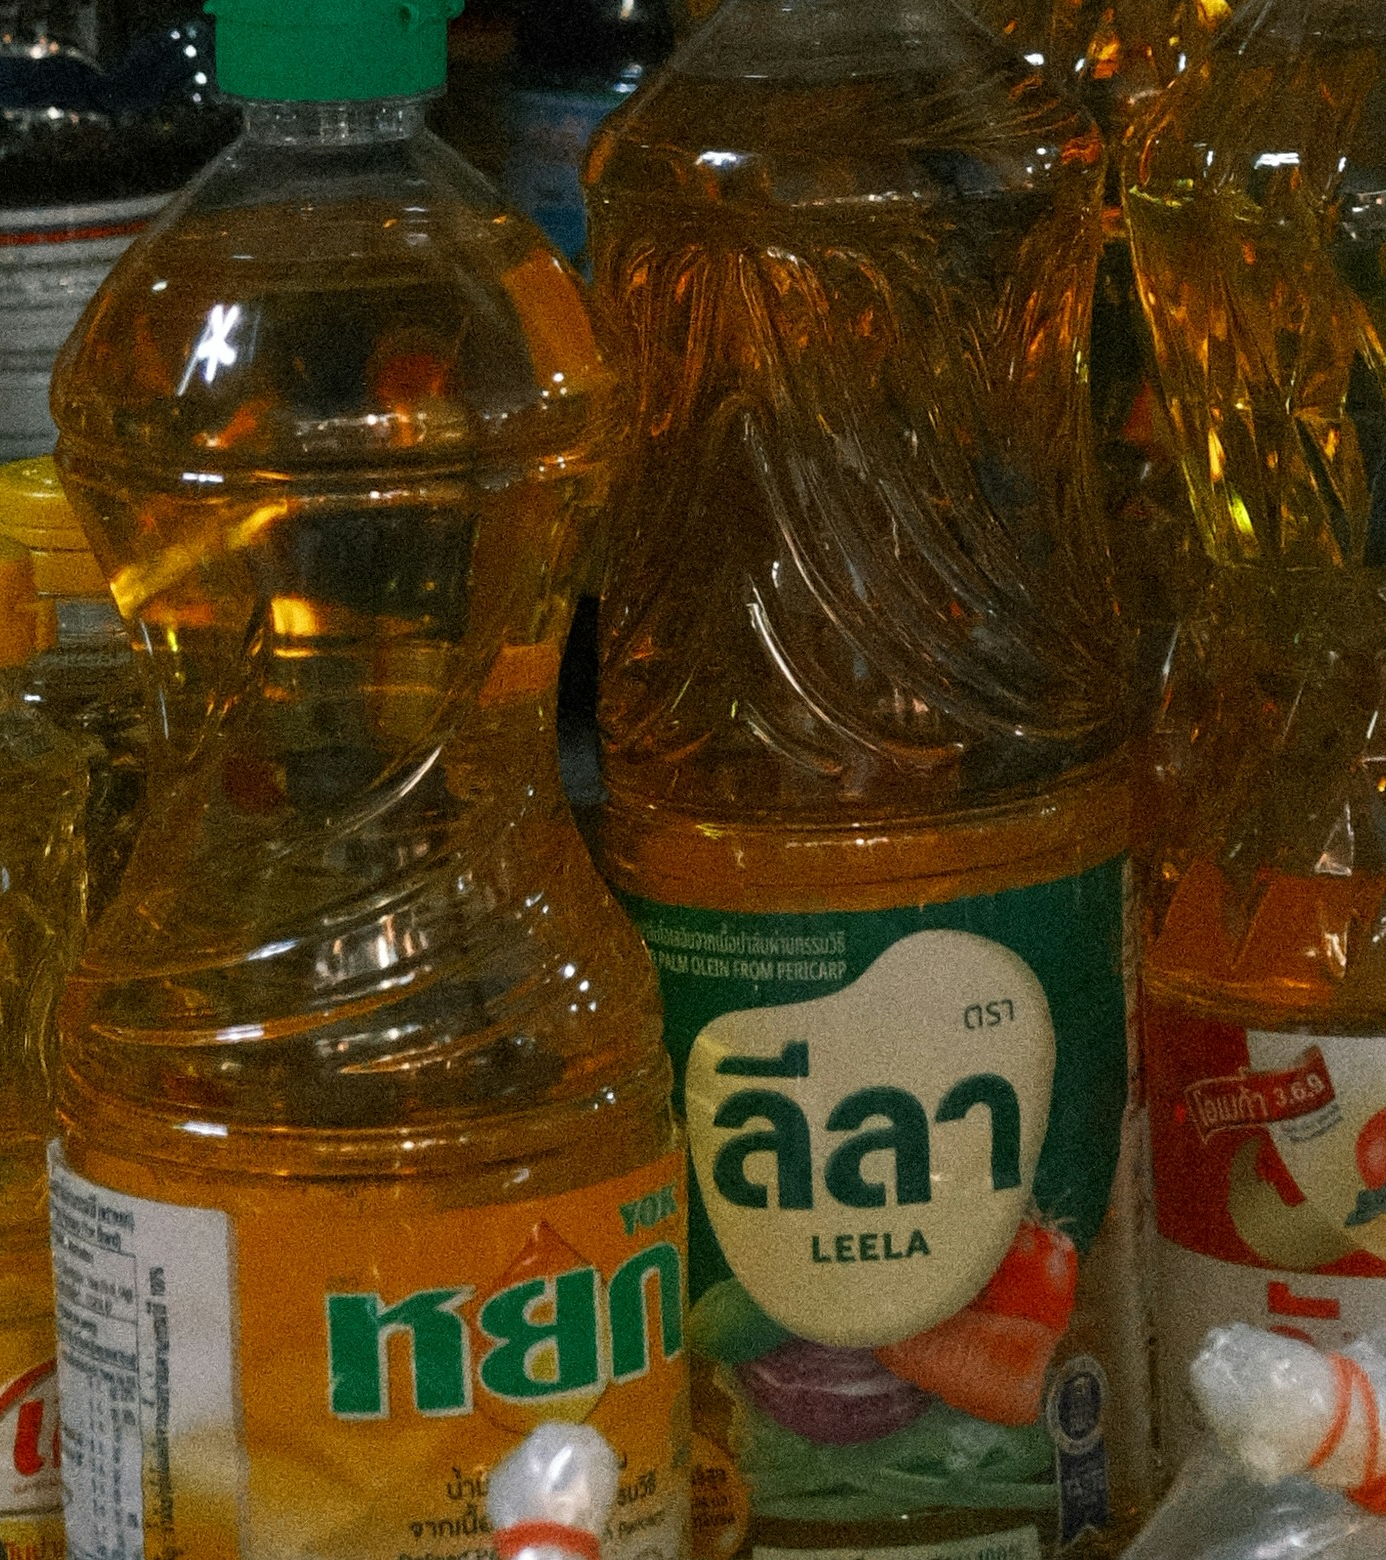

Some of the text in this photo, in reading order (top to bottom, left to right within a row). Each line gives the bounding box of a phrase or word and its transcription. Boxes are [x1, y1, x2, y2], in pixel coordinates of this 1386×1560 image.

[733, 959, 773, 981] FROM
[963, 998, 1015, 1031] ตรา
[711, 1038, 1024, 1214] ลีลา
[620, 1184, 678, 1237] YOK
[813, 1230, 931, 1265] LEELA
[324, 1241, 684, 1422] หยก
